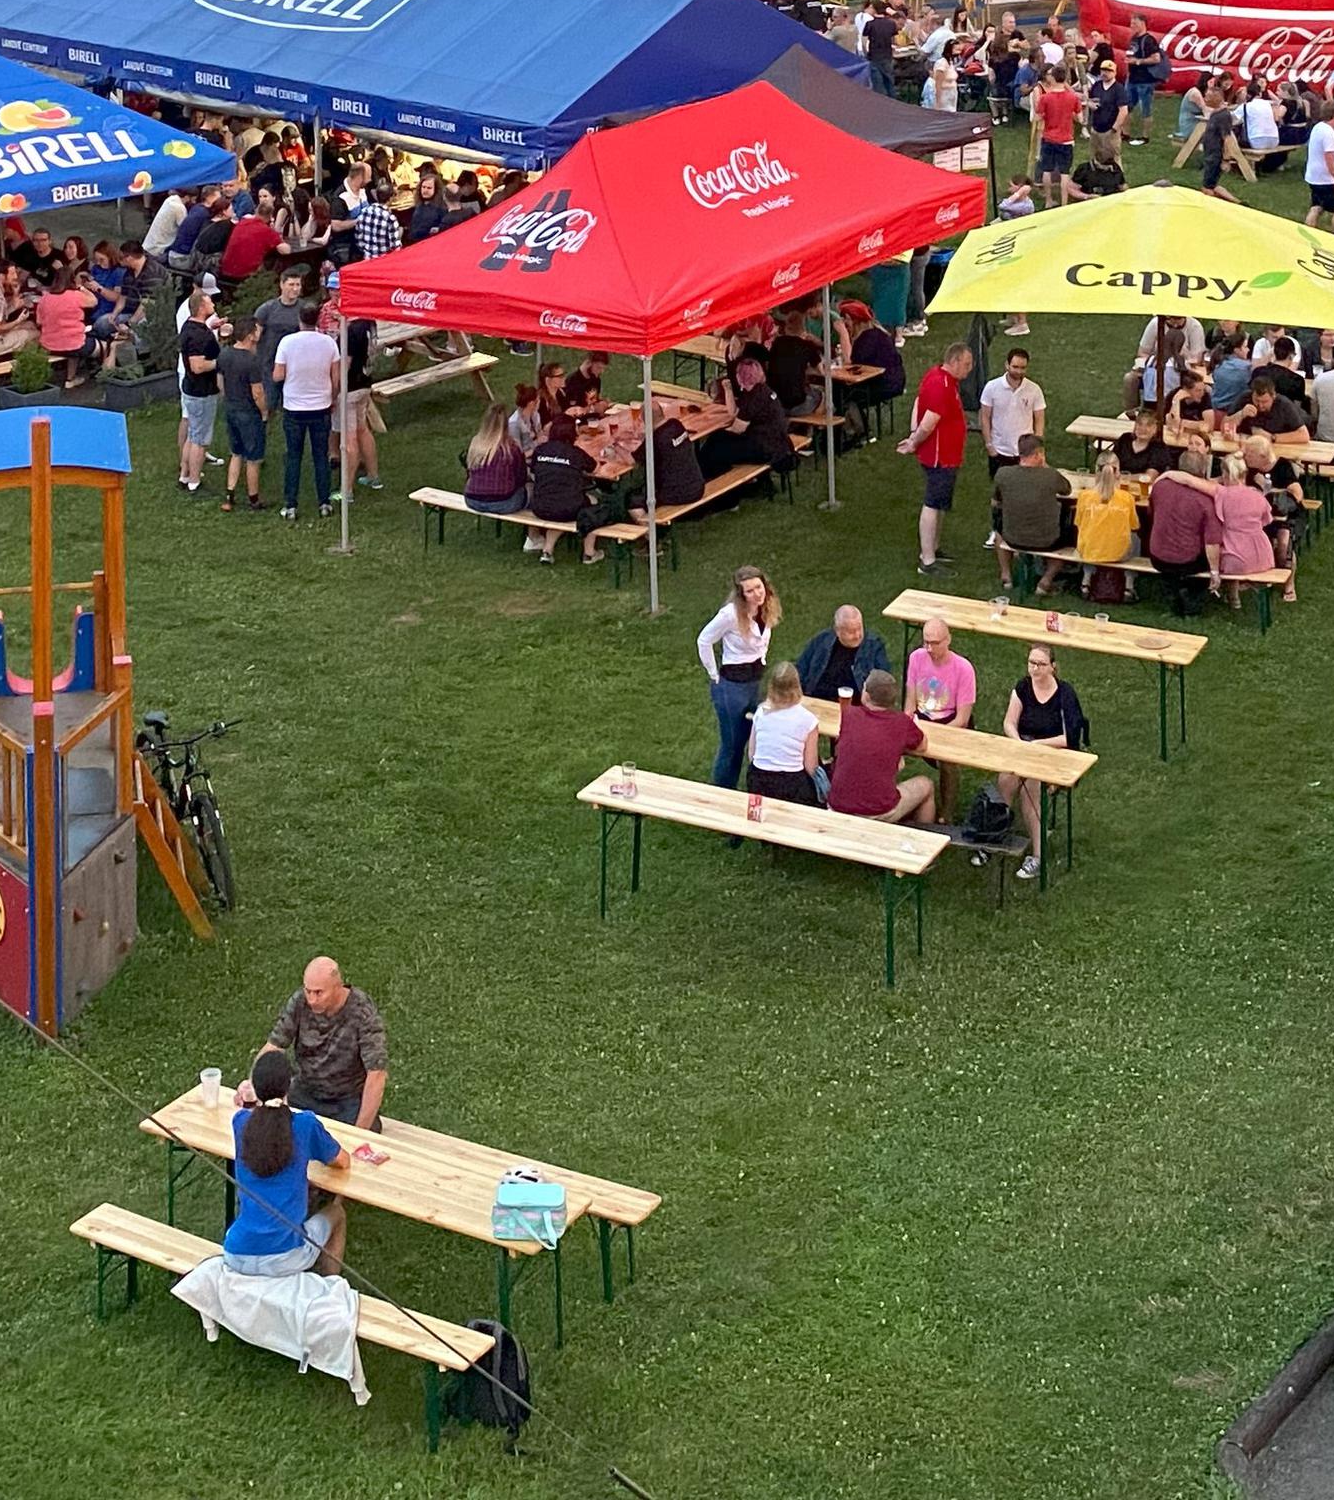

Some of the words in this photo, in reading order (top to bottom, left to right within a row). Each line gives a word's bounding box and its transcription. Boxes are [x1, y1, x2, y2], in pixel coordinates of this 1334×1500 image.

[68, 47, 102, 66] BIRELL
[194, 71, 231, 90] BIRELL
[331, 97, 372, 118] BIRELL
[423, 116, 456, 134] CENTRUM
[481, 125, 527, 147] BIRELL
[682, 139, 794, 209] Coca-Cola
[1065, 262, 1248, 302] Cappy
[390, 287, 439, 311] Coca-Cola
